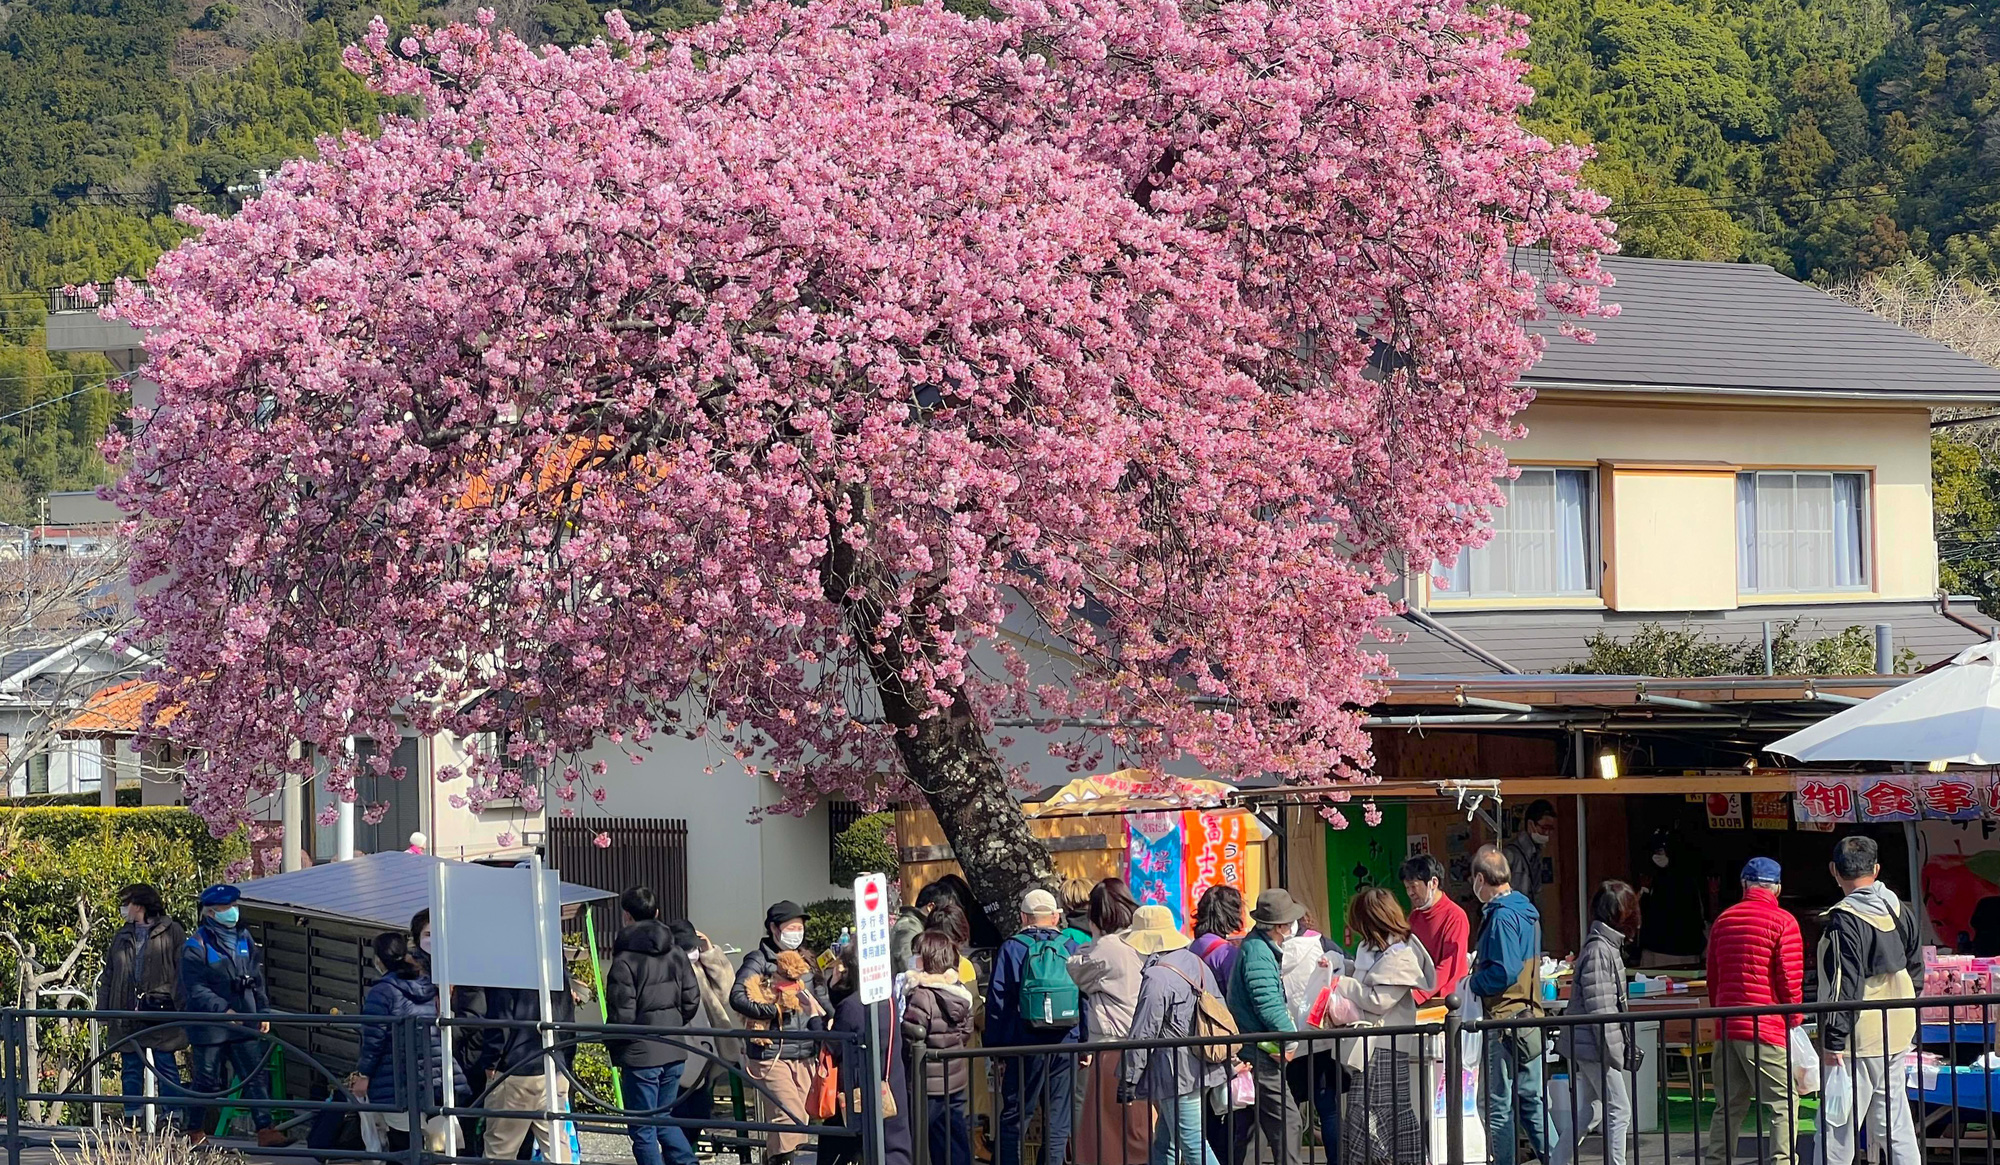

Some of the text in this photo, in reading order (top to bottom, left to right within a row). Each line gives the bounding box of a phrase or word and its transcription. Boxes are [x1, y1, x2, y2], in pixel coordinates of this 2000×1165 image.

[1801, 780, 2000, 818] 御食事
[861, 913, 884, 929] 歩行者
[862, 929, 885, 944] 自転車
